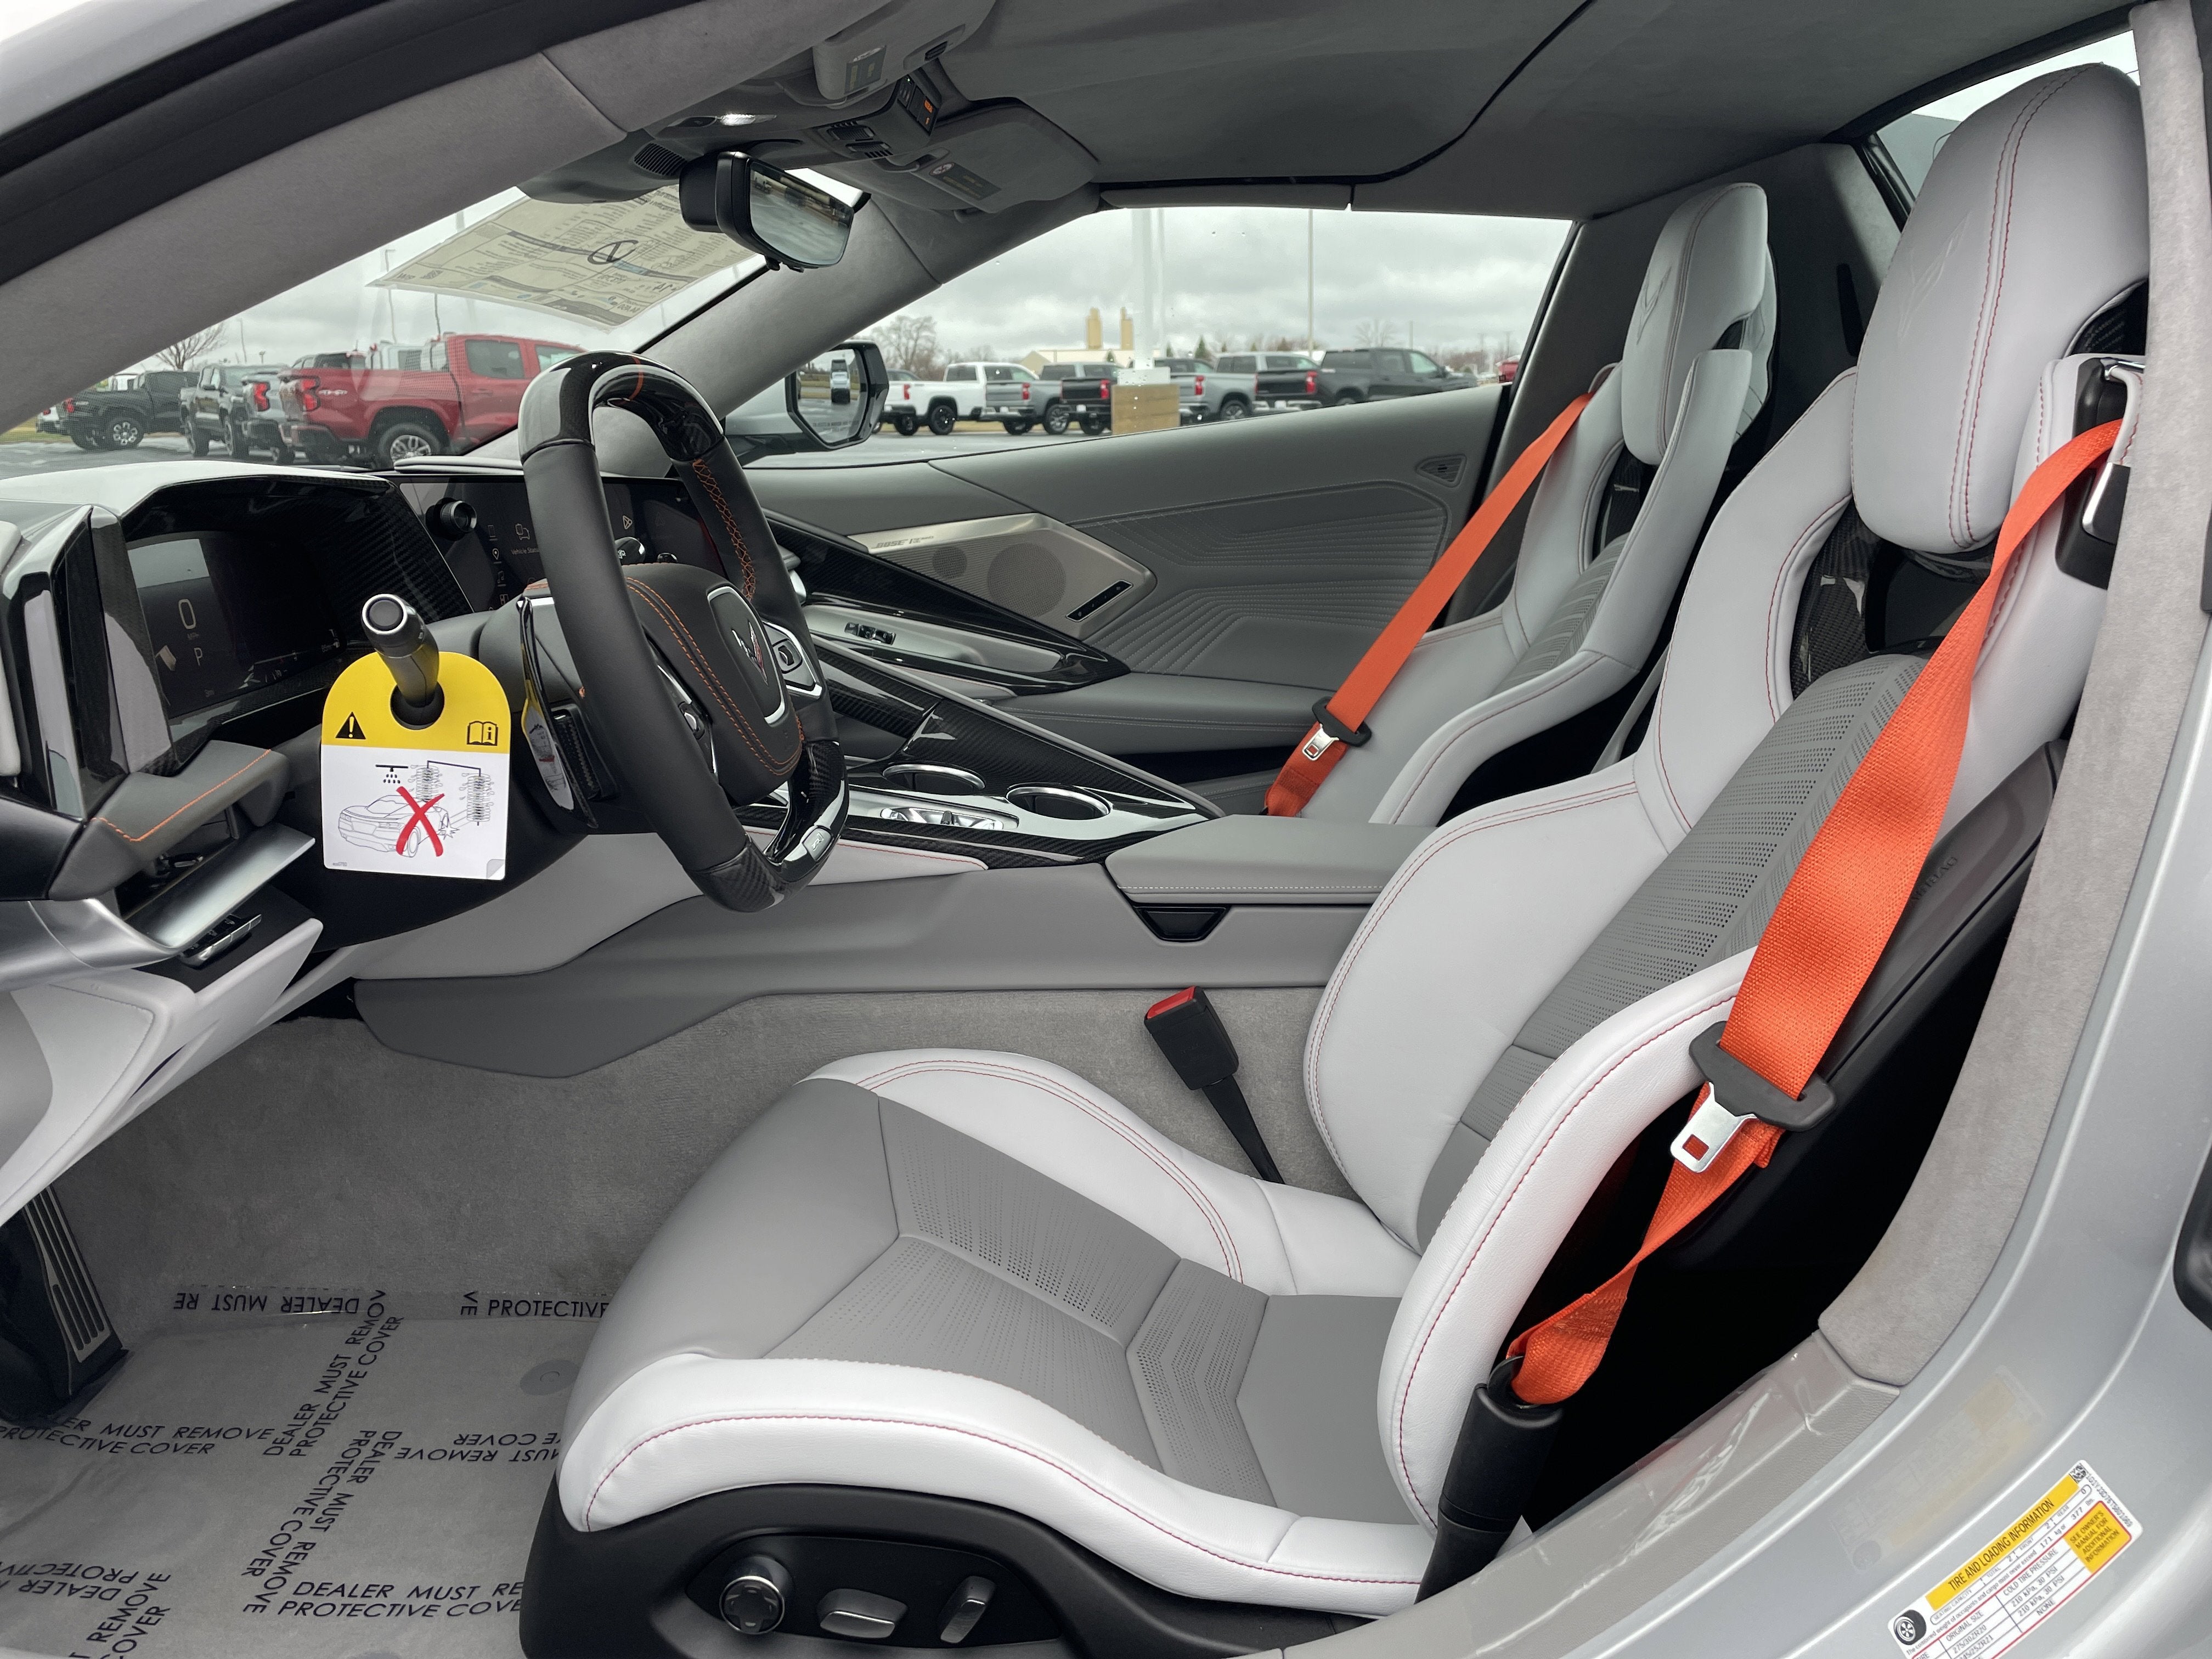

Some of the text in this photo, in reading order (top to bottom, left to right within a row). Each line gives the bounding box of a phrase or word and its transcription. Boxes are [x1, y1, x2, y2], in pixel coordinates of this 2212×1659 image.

[871, 539, 909, 549] BOSE
[178, 599, 196, 630] 0
[194, 647, 203, 666] P
[212, 1294, 267, 1312] MUST
[281, 1296, 359, 1314] DEALER
[289, 1317, 404, 1457] PROTECTIVE COVER
[262, 1403, 320, 1455] DEALER
[313, 1354, 352, 1393] MUST
[100, 1423, 165, 1438] MUST
[173, 1426, 274, 1440] REMOVE
[453, 1434, 537, 1446] COVER
[130, 1442, 215, 1455] COVER
[394, 1447, 498, 1462] REMOVE
[241, 1430, 377, 1577] PROTECTIVE COVER
[243, 1431, 402, 1613] DEALER MUST REMOVE
[2069, 1510, 2105, 1544] SEE OWNER'S
[2074, 1517, 2108, 1549] MANUAL FOR
[1948, 1498, 2055, 1590] TIRE AND LOADING INFORMATION
[2080, 1525, 2113, 1554] ADDITIONAL
[2083, 1529, 2121, 1563] INFORMATION
[0, 1562, 139, 1583] PROTECTIV
[1915, 1630, 1937, 1650] combined
[1935, 1619, 1951, 1634] weight
[1955, 1598, 1979, 1620] occupants
[1977, 1591, 1987, 1601] and
[1985, 1582, 2000, 1595] cargo
[2010, 1564, 2022, 1576] never
[2020, 1549, 2037, 1565] exceed
[2070, 1506, 2084, 1520] 377
[1986, 1565, 2001, 1578] TOTAL
[2002, 1547, 2059, 1596] COLD TIRE PRESSURE
[2010, 1594, 2023, 1607] 210
[2036, 1575, 2046, 1585] 30
[2044, 1565, 2057, 1578] PSI
[19, 1579, 122, 1600] DEALER
[292, 1582, 394, 1599] DEALER
[407, 1585, 481, 1600] MUST
[2017, 1604, 2031, 1617] 210
[2043, 1585, 2053, 1595] 30
[2051, 1574, 2065, 1588] PSI
[86, 1573, 171, 1642] REMOVE
[278, 1599, 522, 1618] PROTECTIVE COVE
[2035, 1598, 2056, 1616] NONE
[1945, 1610, 1984, 1643] ORIGINAL SIZE
[1961, 1634, 1994, 1659] 45/25ZR21
